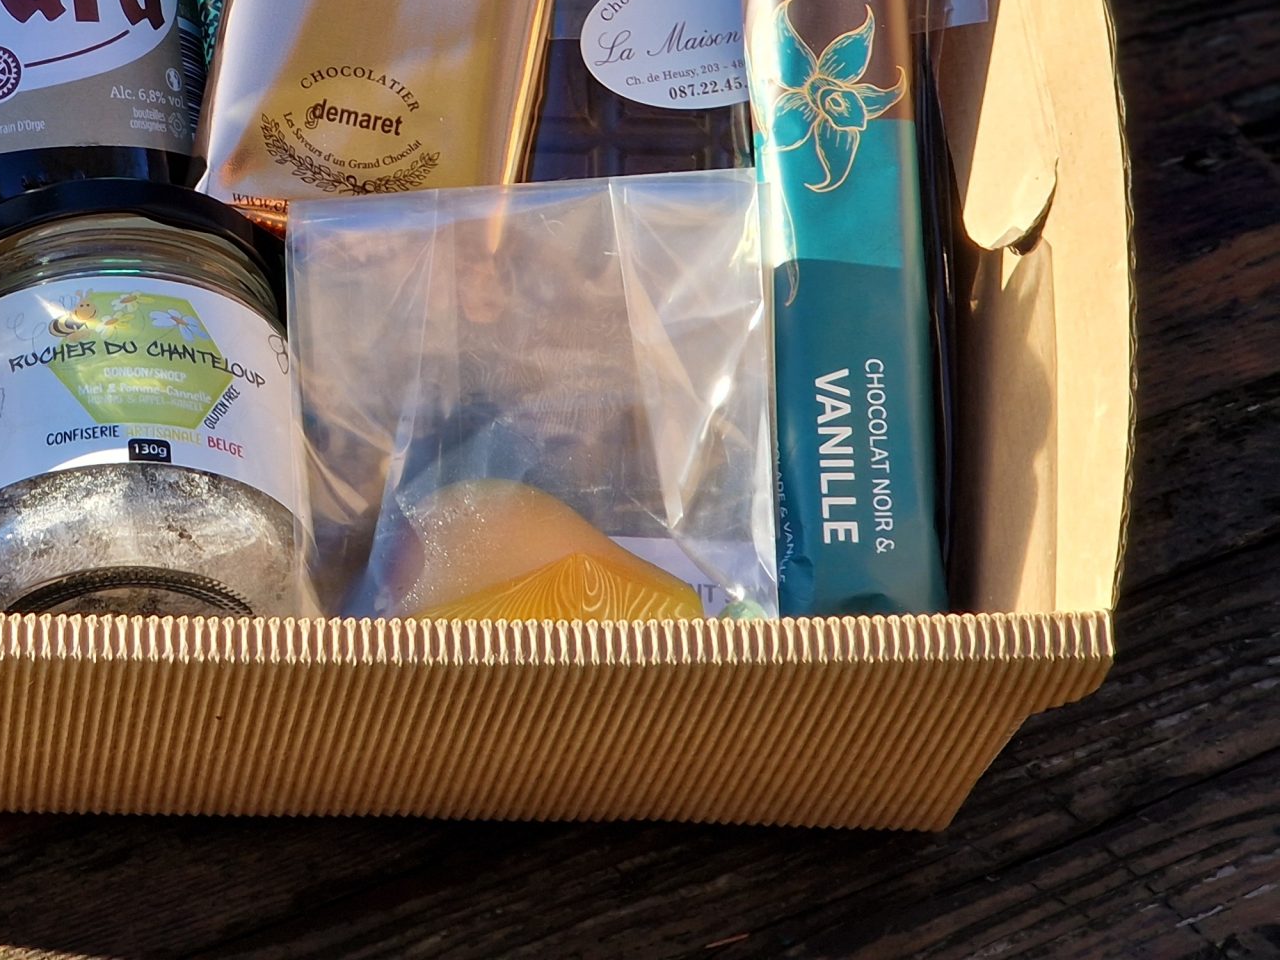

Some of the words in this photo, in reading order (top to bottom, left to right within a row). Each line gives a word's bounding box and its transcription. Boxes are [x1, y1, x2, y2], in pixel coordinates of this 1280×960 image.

[594, 29, 636, 67] La
[647, 21, 742, 57] Maison
[300, 65, 420, 113] CHOCOLATIER
[625, 76, 644, 87] Ch.
[647, 72, 660, 84] de
[662, 67, 700, 82] Heusy,
[700, 63, 720, 75] 203
[730, 59, 745, 71] 48
[668, 76, 749, 101] 087.22.45.
[110, 85, 136, 100] Alc.
[138, 88, 166, 104] 6,8%
[17, 119, 46, 133] D'Orge
[312, 98, 403, 136] demaret
[323, 152, 346, 167] d'un
[348, 159, 381, 169] Grand
[382, 139, 423, 166] Chocolat
[8, 340, 97, 373] RUCHER
[104, 340, 138, 355] DU
[146, 342, 266, 388] CHANTELOUP
[203, 400, 229, 430] GLUTEN
[223, 384, 241, 408] FREE
[864, 358, 890, 473] CHOCOLAT
[46, 425, 120, 446] CONFISERIE
[207, 435, 245, 458] BELGE
[133, 443, 168, 458] 130g
[815, 368, 859, 544] VANILLE
[871, 478, 894, 532] NOIR
[875, 536, 895, 554] &
